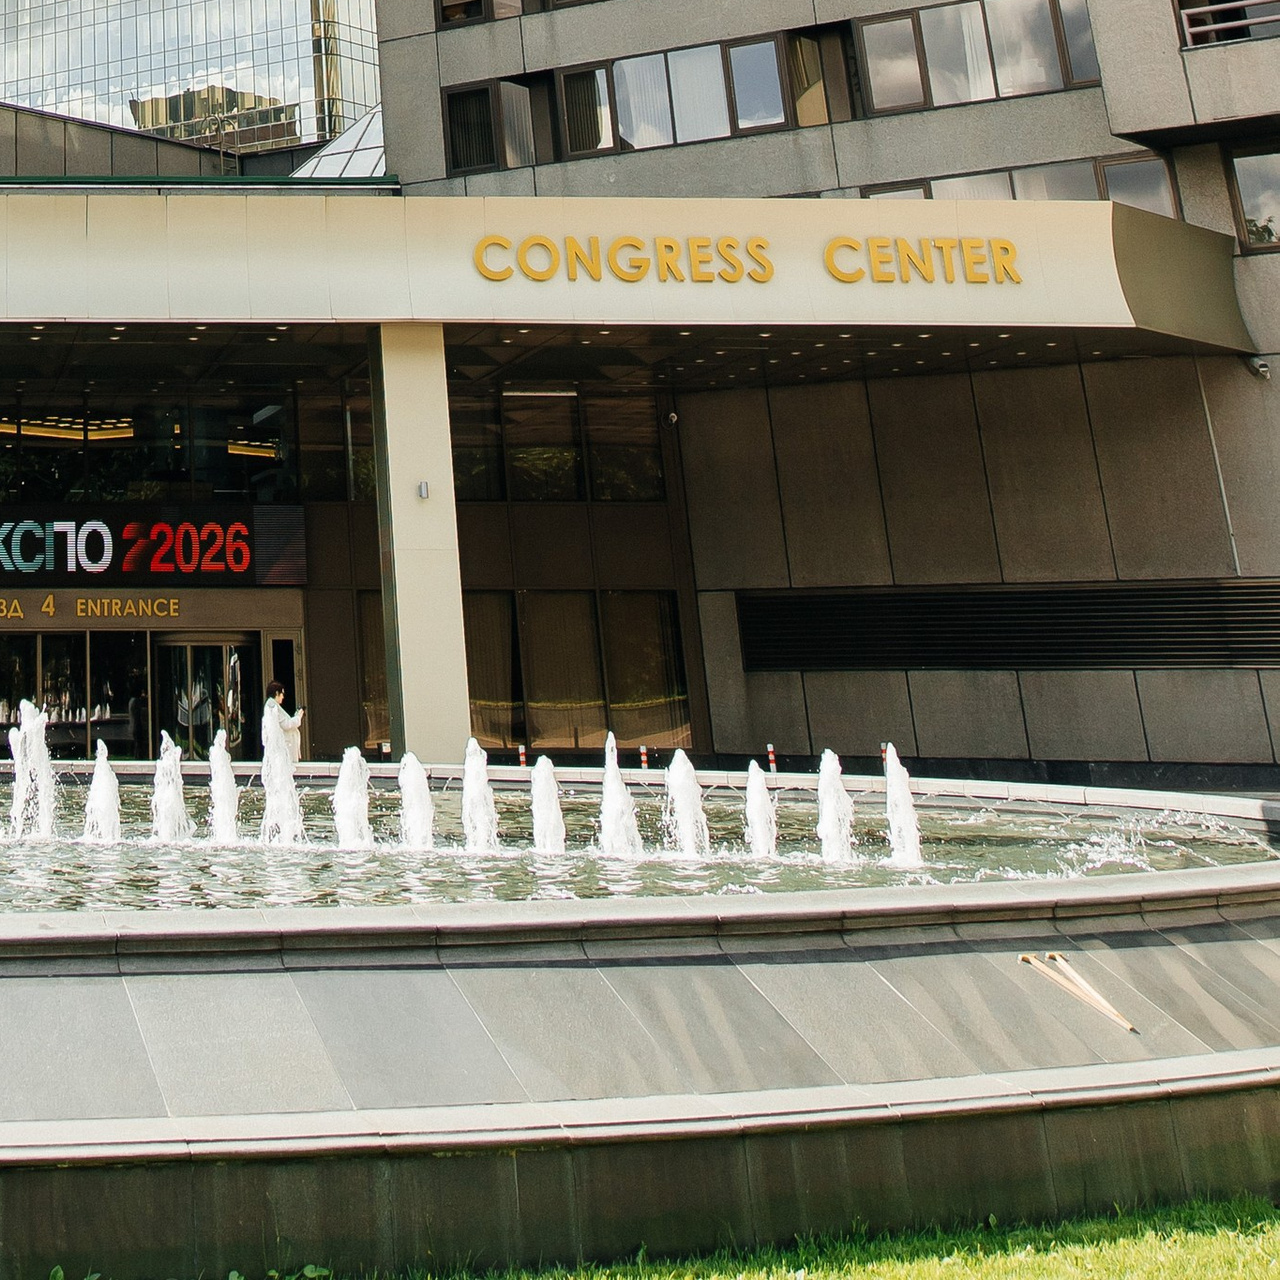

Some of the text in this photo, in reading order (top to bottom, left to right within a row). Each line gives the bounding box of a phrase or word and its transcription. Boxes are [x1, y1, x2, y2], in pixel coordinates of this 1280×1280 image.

[474, 234, 1023, 283] CONGRESS CENTER
[41, 594, 55, 616] 4
[76, 598, 179, 617] ENTRANCE
